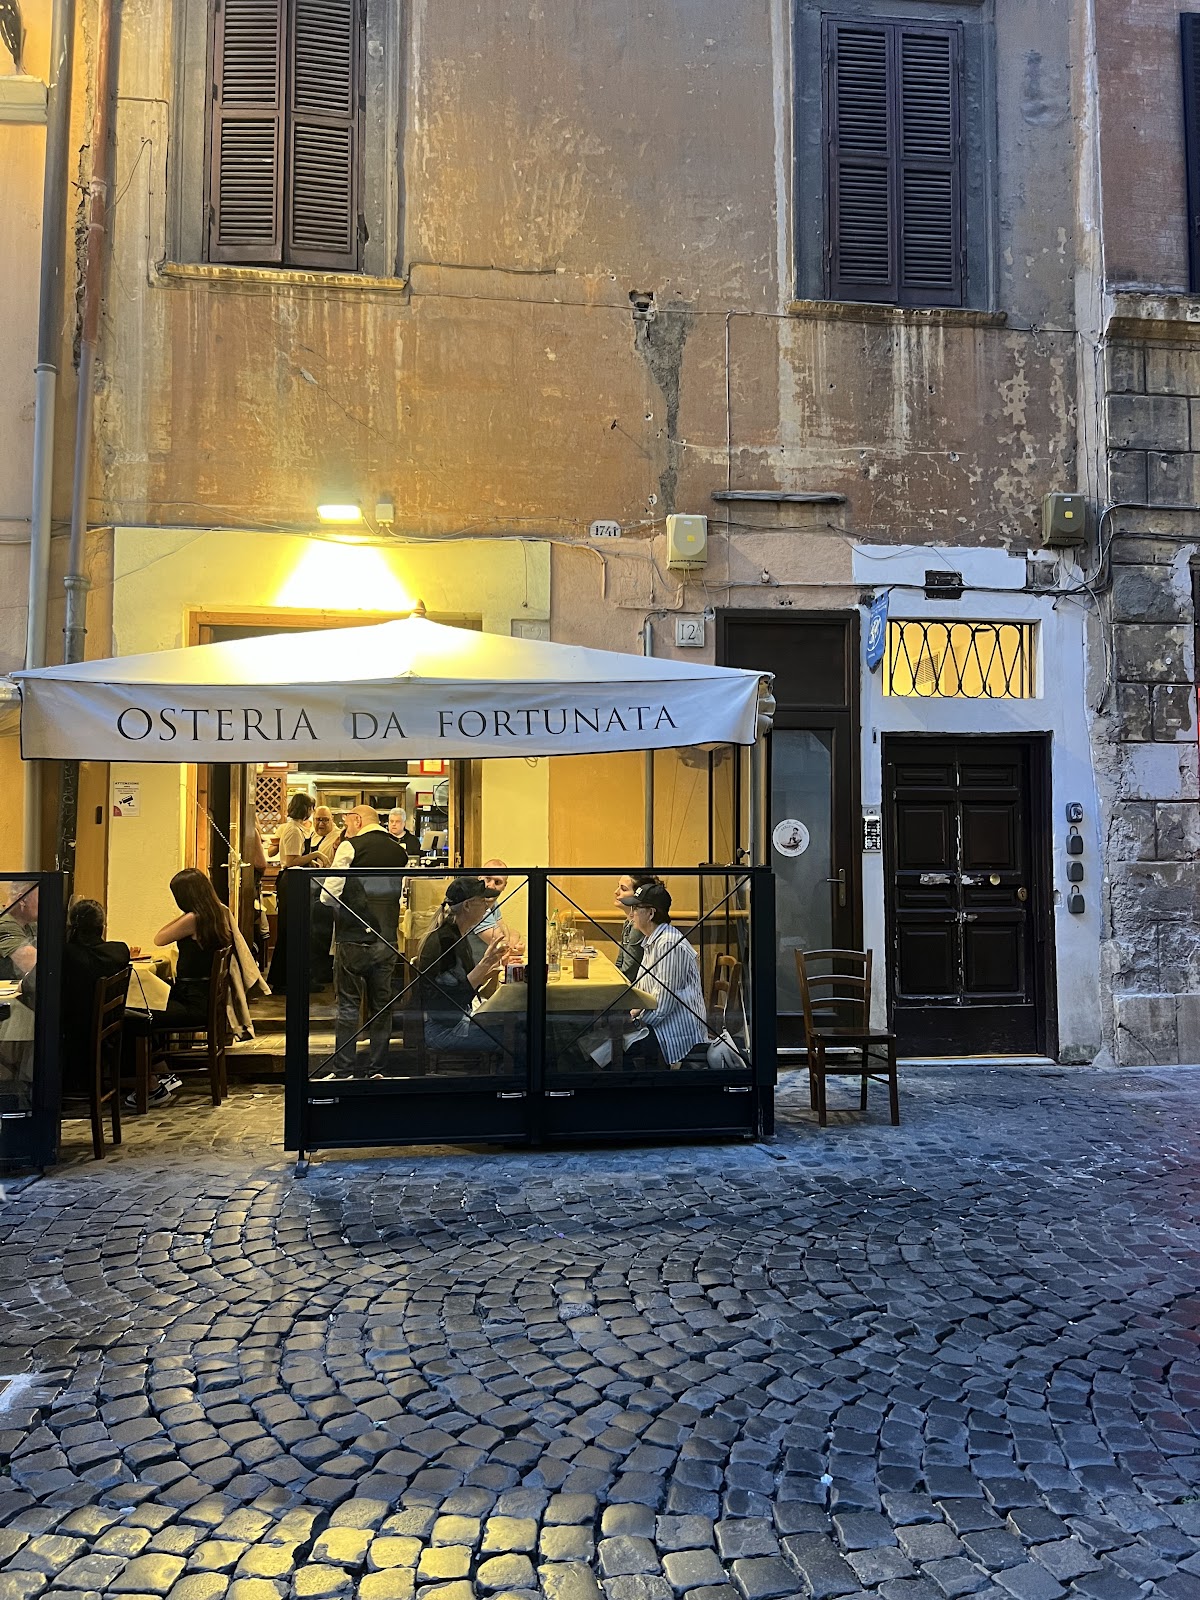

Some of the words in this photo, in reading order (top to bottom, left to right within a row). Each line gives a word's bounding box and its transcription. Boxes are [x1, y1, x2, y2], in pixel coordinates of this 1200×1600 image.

[595, 525, 617, 537] 1741
[116, 707, 319, 741] OSTERIA
[350, 711, 409, 740] DA
[437, 705, 679, 738] FORTUNATA
